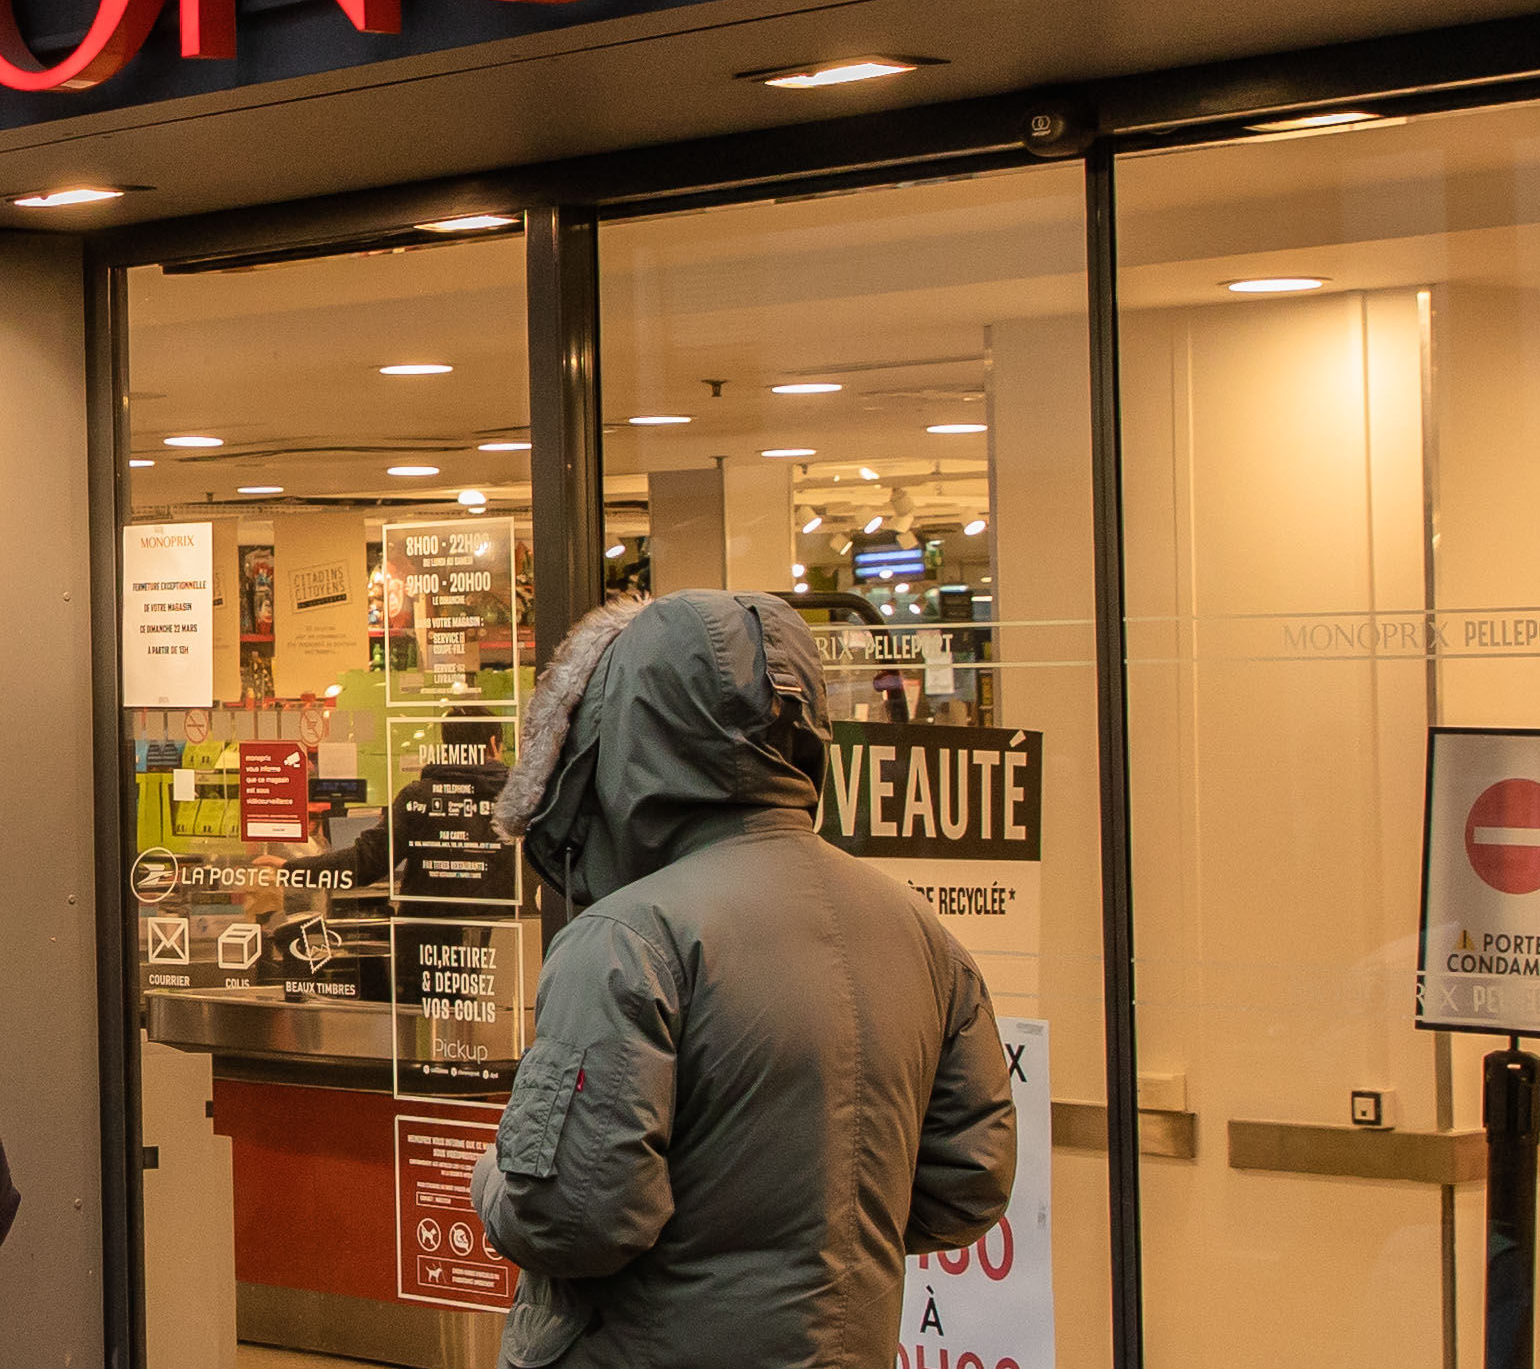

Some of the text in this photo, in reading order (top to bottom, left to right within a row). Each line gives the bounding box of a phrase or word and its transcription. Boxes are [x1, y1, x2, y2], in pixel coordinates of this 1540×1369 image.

[141, 535, 194, 549] MONOPRIX
[406, 535, 439, 556] 8H00
[133, 581, 206, 591] FERMETURE EXCEPTIONNELLE
[450, 572, 491, 593] 20H00
[144, 603, 192, 612] DE VOTRE MAGASIN
[147, 624, 172, 633] DIMANCHE
[174, 624, 180, 633] 22
[182, 624, 197, 632] MARS
[152, 646, 169, 654] PARTIR
[420, 744, 486, 765] PAIEMENT
[813, 730, 1027, 840] VEAUTÉ
[182, 867, 353, 890] LA POSTE RELAIS
[149, 975, 190, 987] COURRIER
[225, 978, 250, 989] COLIS
[286, 981, 355, 995] BEAUX TIMBRES
[422, 971, 495, 996] & DÉPOSEZ
[422, 997, 496, 1023] VOS COLIS
[433, 1038, 488, 1064] Pickup
[920, 1284, 944, 1336] À
